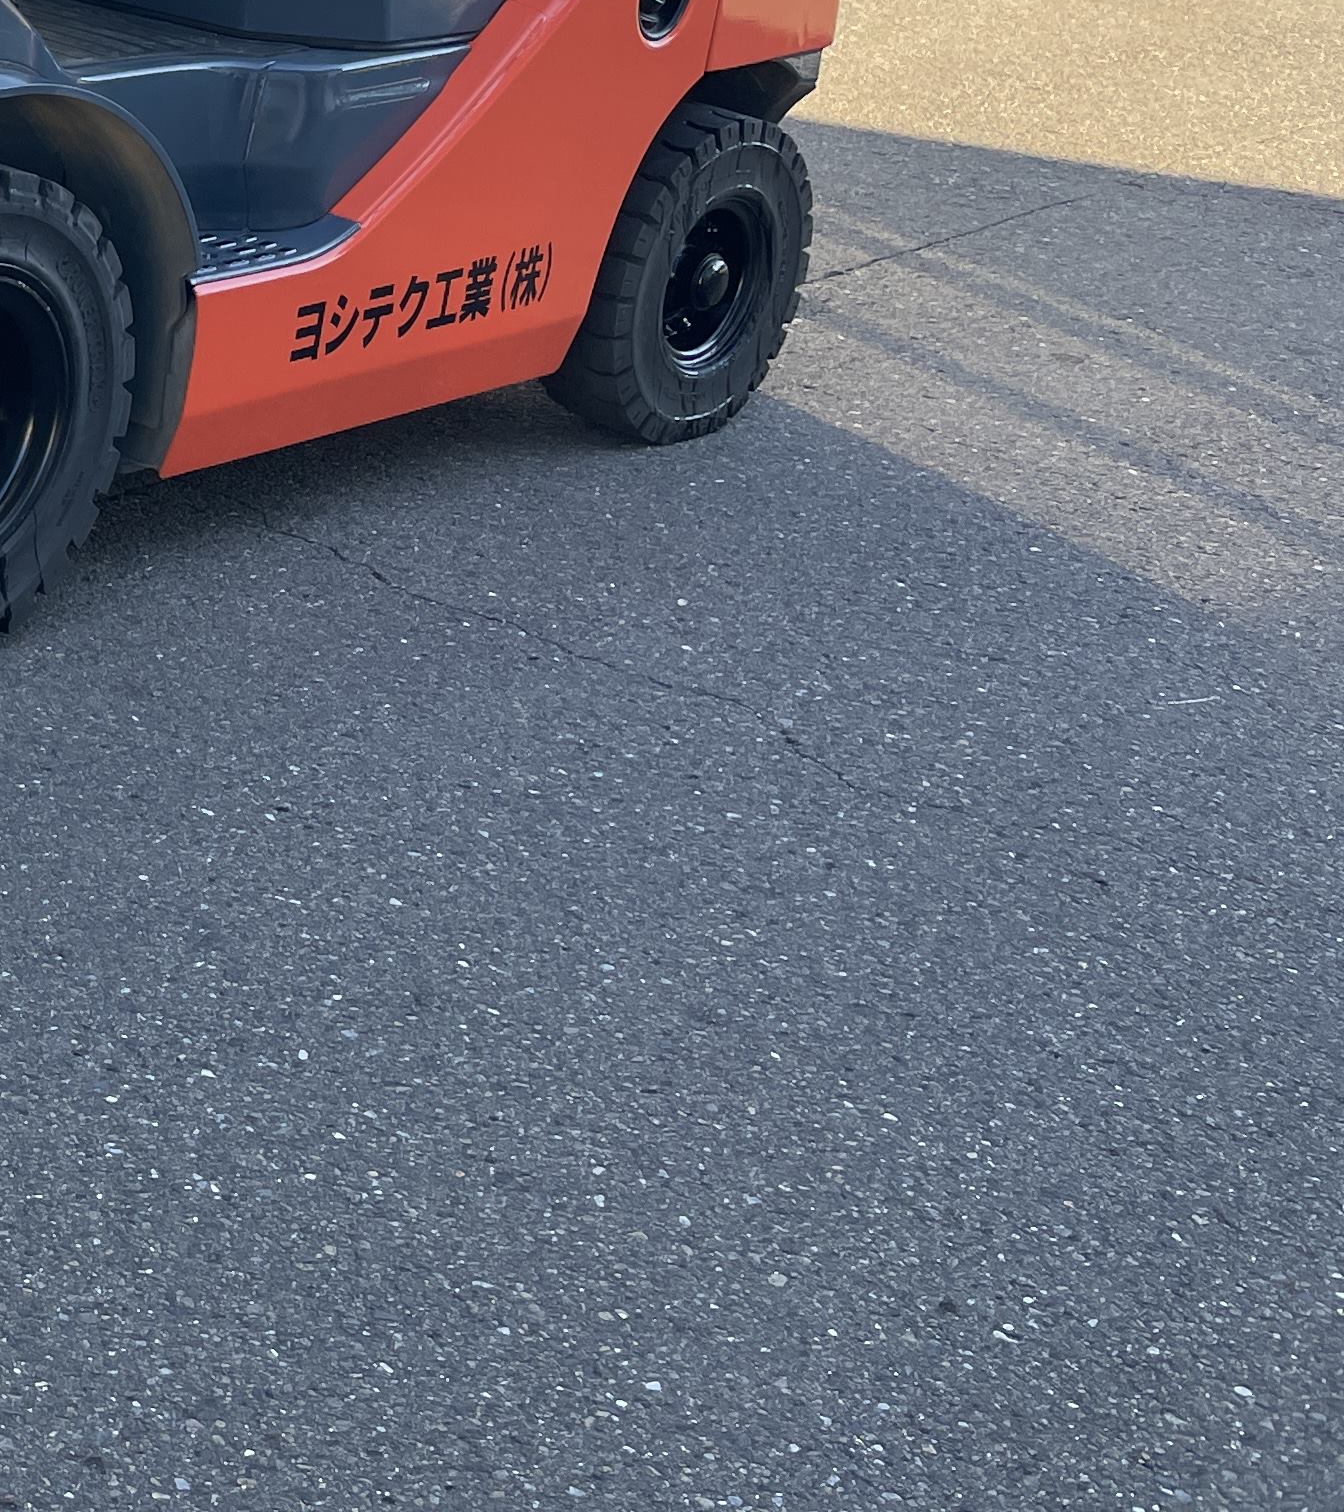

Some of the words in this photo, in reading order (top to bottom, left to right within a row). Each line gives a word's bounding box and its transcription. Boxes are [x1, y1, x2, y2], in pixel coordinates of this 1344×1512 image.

[289, 241, 553, 363] ヨシテク工業(株)
